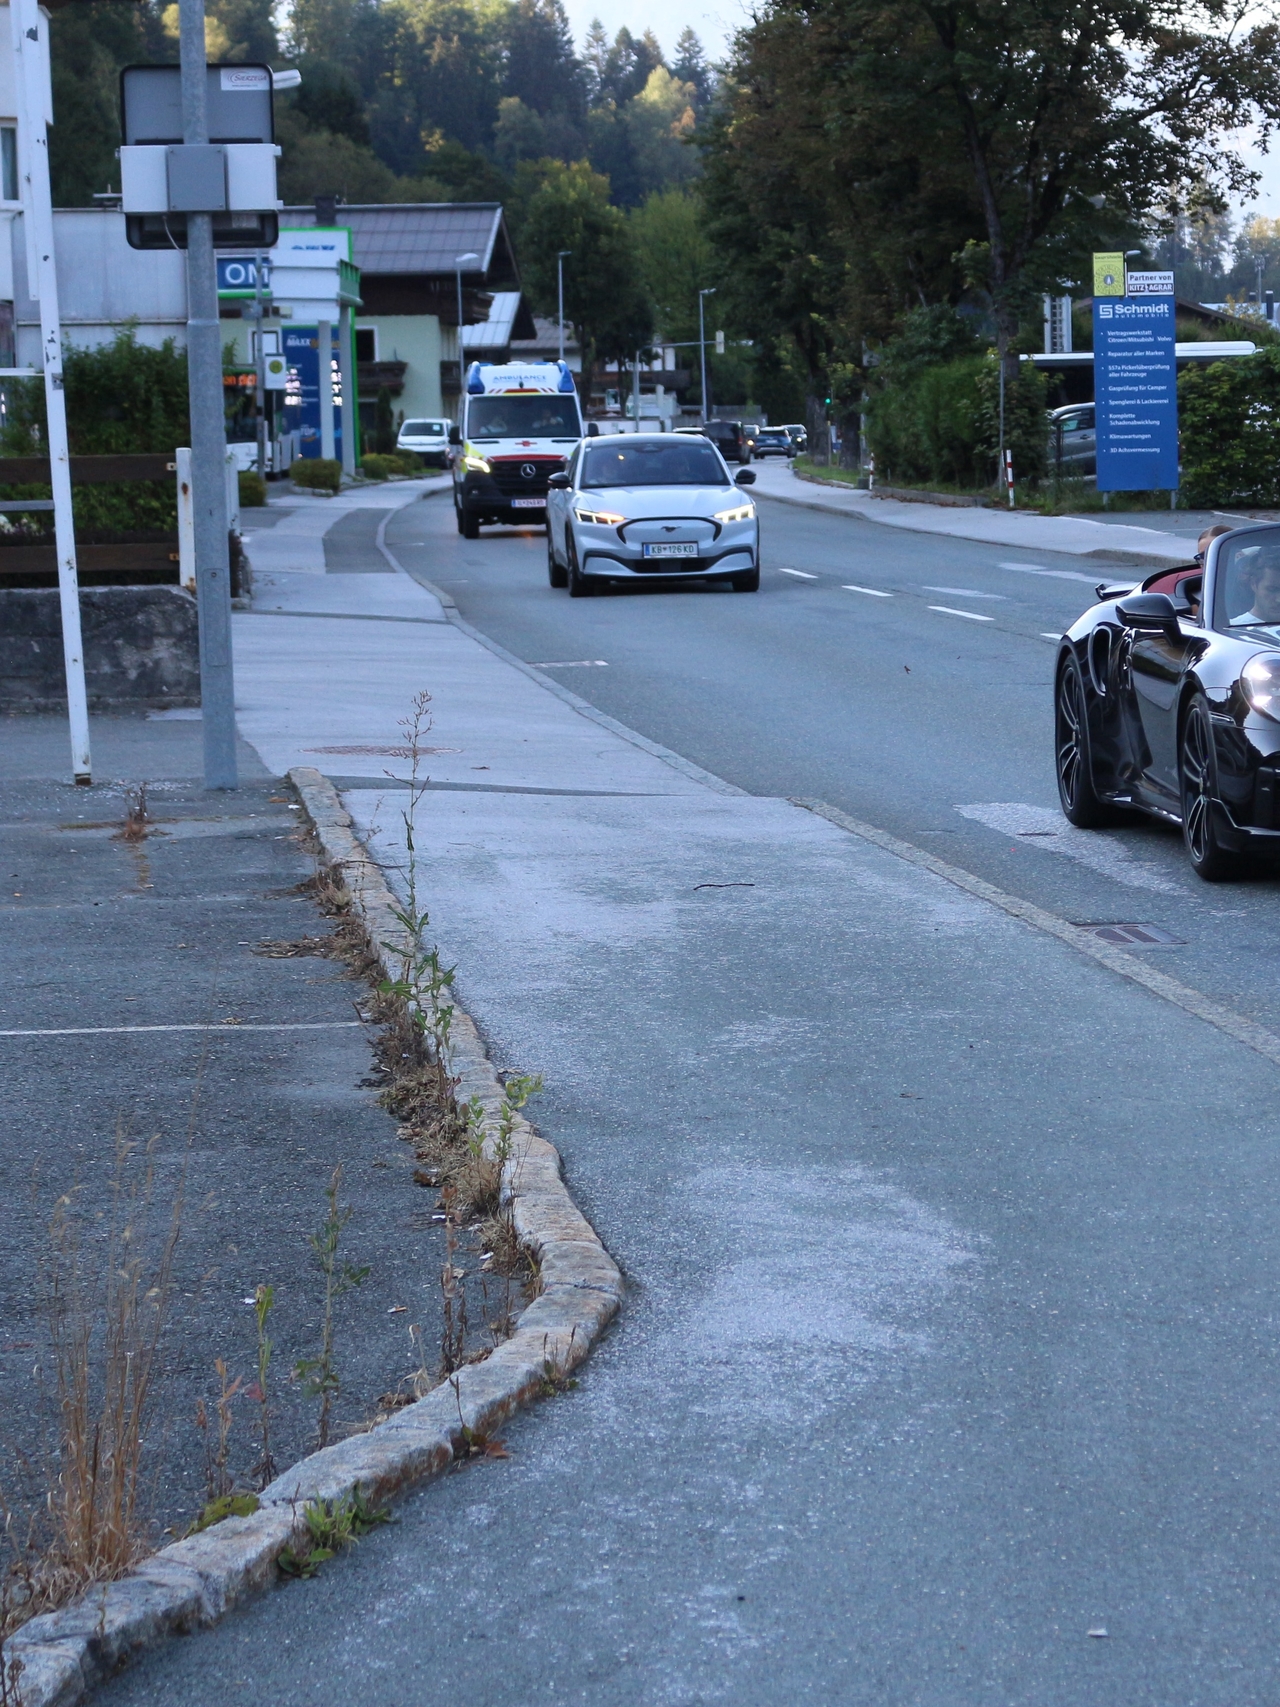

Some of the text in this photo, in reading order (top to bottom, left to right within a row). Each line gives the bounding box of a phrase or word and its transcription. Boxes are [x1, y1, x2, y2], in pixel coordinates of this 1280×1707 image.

[1149, 283, 1173, 291] AGRAR
[1115, 304, 1169, 314] Schmidt
[651, 545, 662, 554] KB
